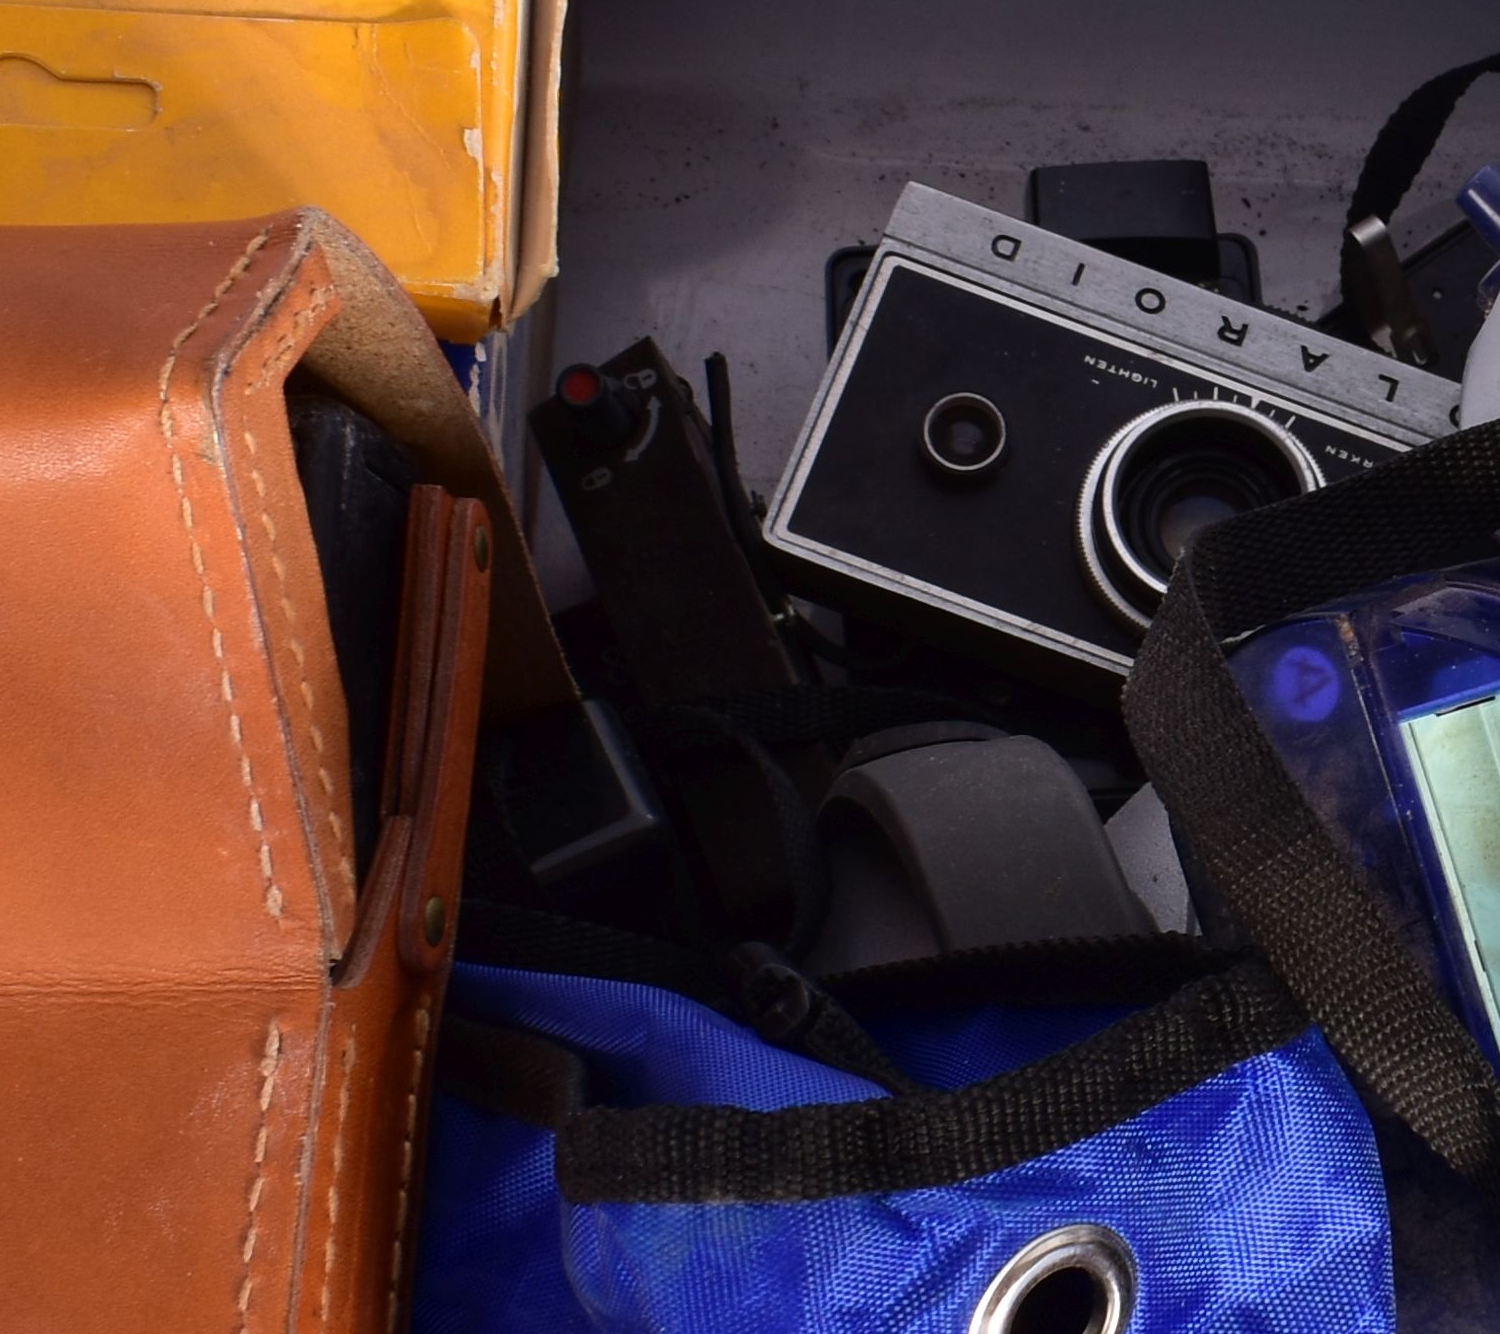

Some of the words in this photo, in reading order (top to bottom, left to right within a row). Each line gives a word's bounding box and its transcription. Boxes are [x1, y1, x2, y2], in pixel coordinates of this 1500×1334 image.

[990, 231, 1461, 430] LAROID
[1082, 353, 1159, 391] LIGHTEN
[1323, 443, 1374, 470] RKEN
